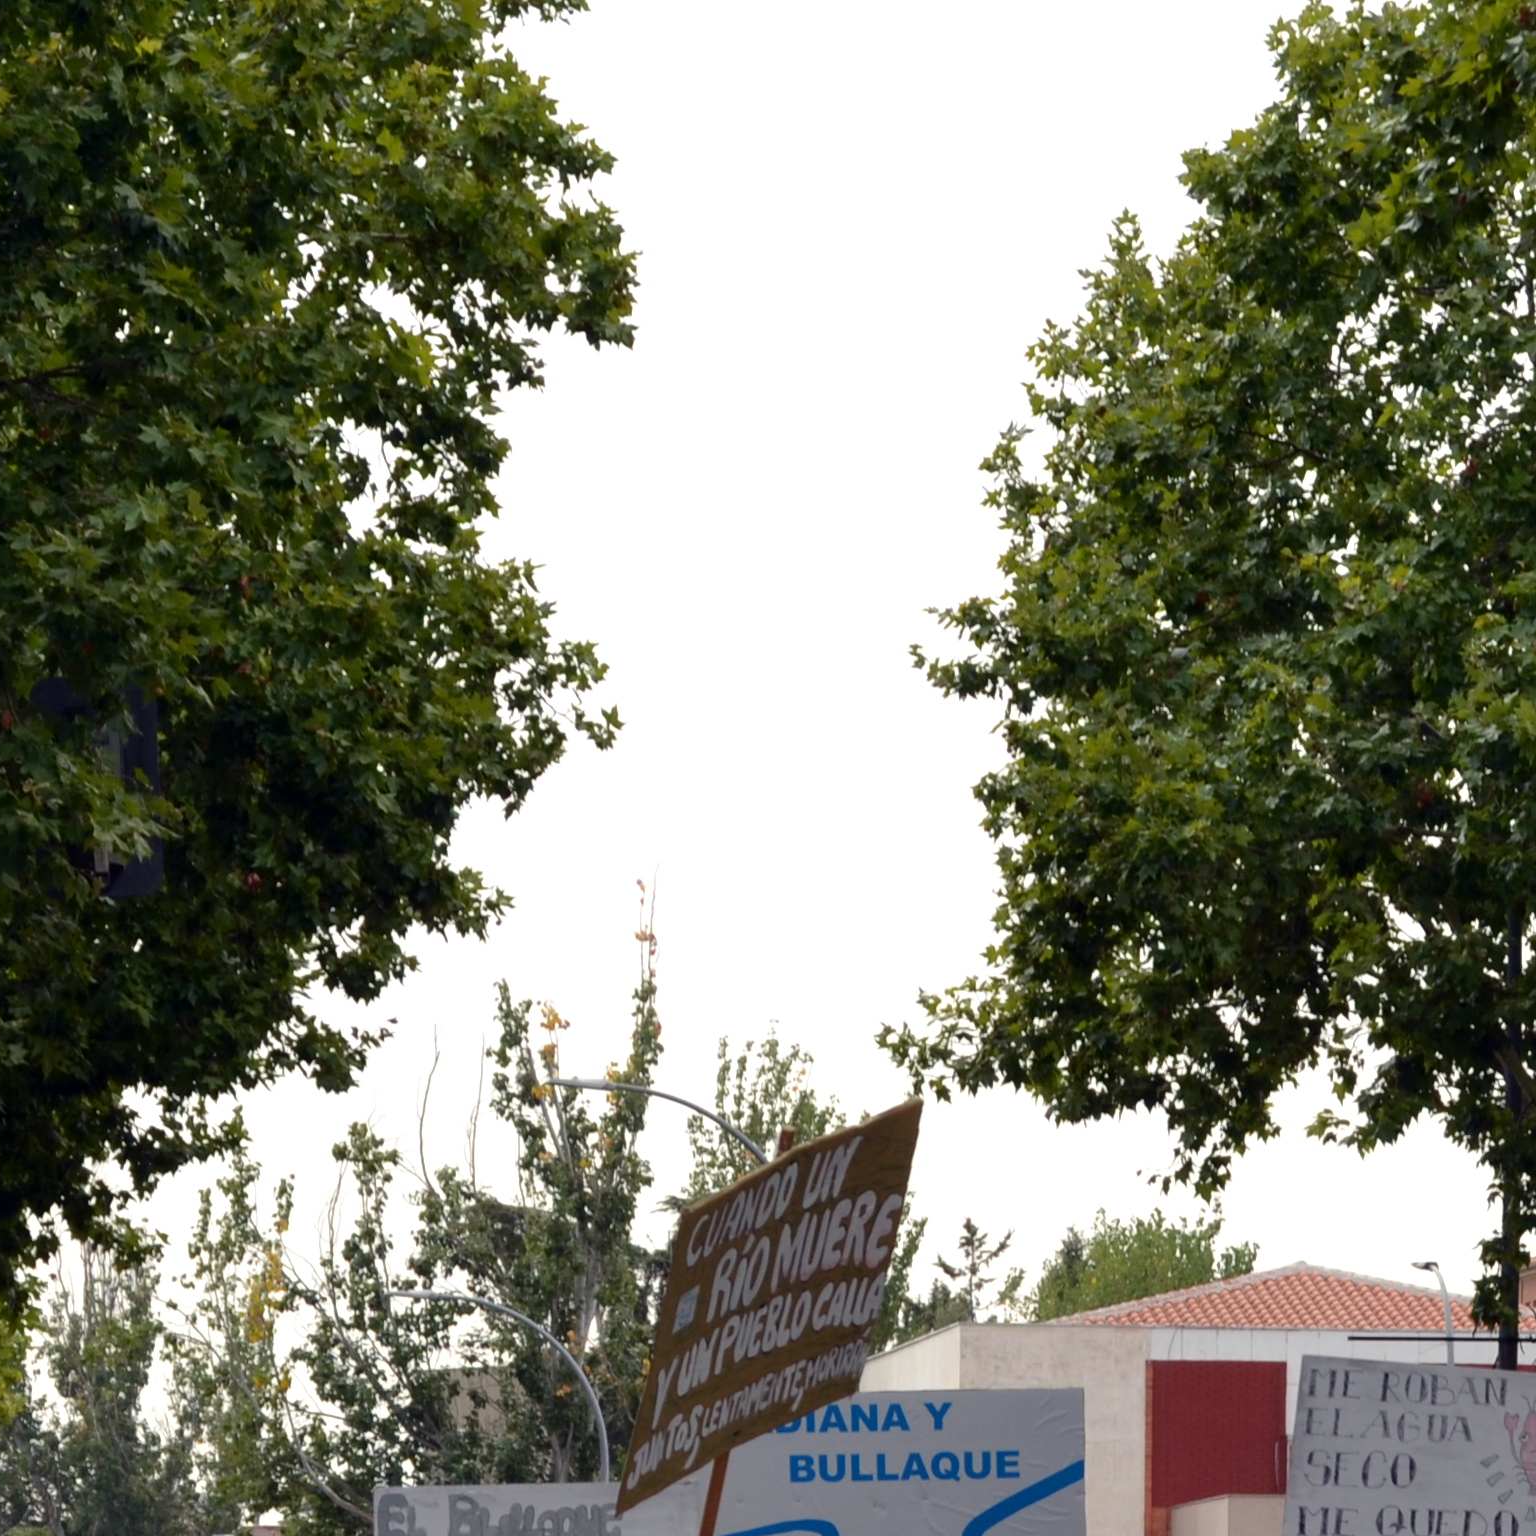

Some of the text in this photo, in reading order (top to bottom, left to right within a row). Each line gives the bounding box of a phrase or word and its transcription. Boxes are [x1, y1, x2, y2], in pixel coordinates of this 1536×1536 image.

[686, 1135, 862, 1267] CUANDO UN
[707, 1232, 771, 1322] RÍO
[770, 1192, 904, 1292] MUERE
[652, 1357, 679, 1430] Y
[676, 1328, 722, 1397] UN
[715, 1293, 814, 1375] PUEBLO
[811, 1275, 888, 1331] CALLA
[1307, 1368, 1509, 1407] ME ROBAN
[924, 1401, 953, 1431] Y
[1305, 1406, 1474, 1444] EL AGUA
[789, 1450, 1021, 1484] BULLAQUE
[1303, 1450, 1418, 1490] SECO
